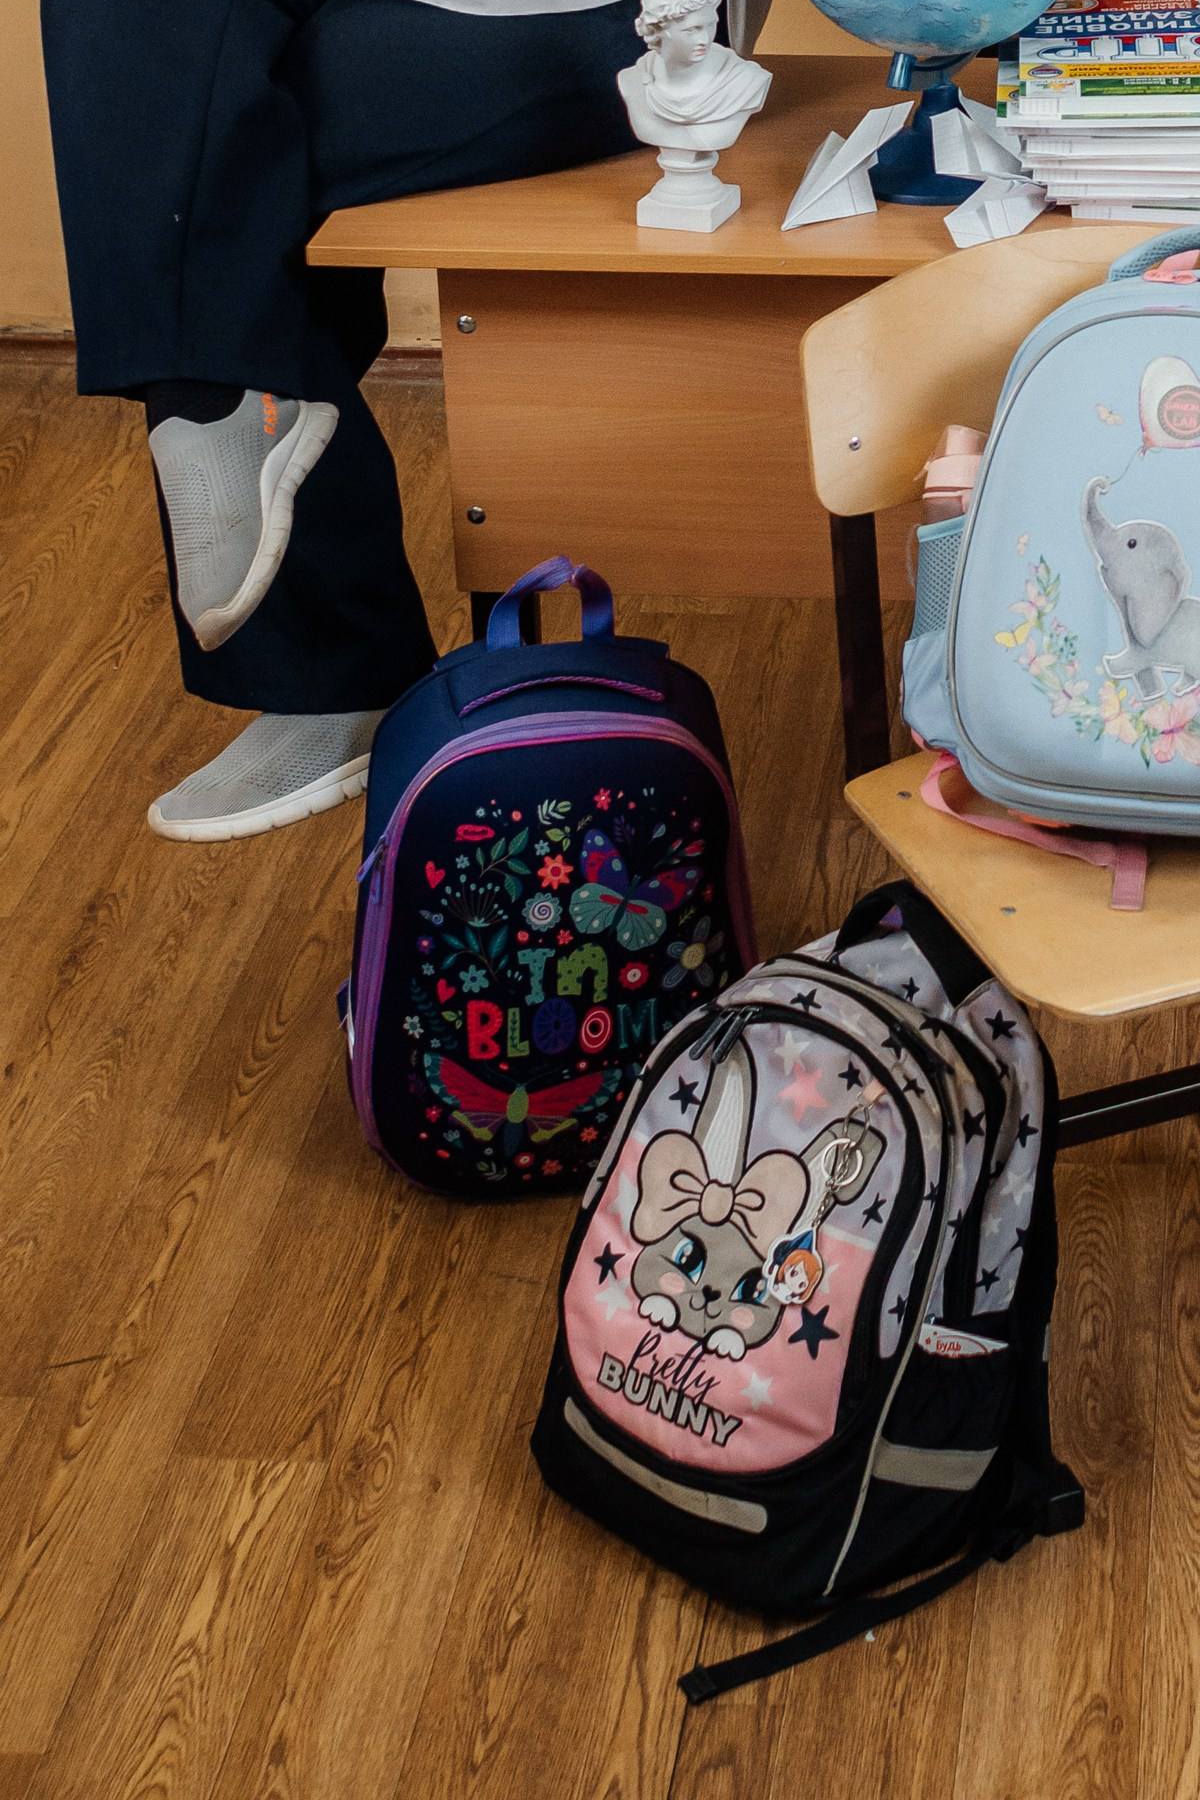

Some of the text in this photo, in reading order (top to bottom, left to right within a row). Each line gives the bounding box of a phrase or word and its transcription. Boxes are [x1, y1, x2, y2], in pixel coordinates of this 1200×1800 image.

[1034, 20, 1198, 35] ТИПОВЫЕ
[1038, 10, 1193, 25] ЗАДАНИЯ
[465, 997, 658, 1061] BLOOM
[628, 1329, 722, 1404] Pretty
[597, 1351, 744, 1447] BUNNY
